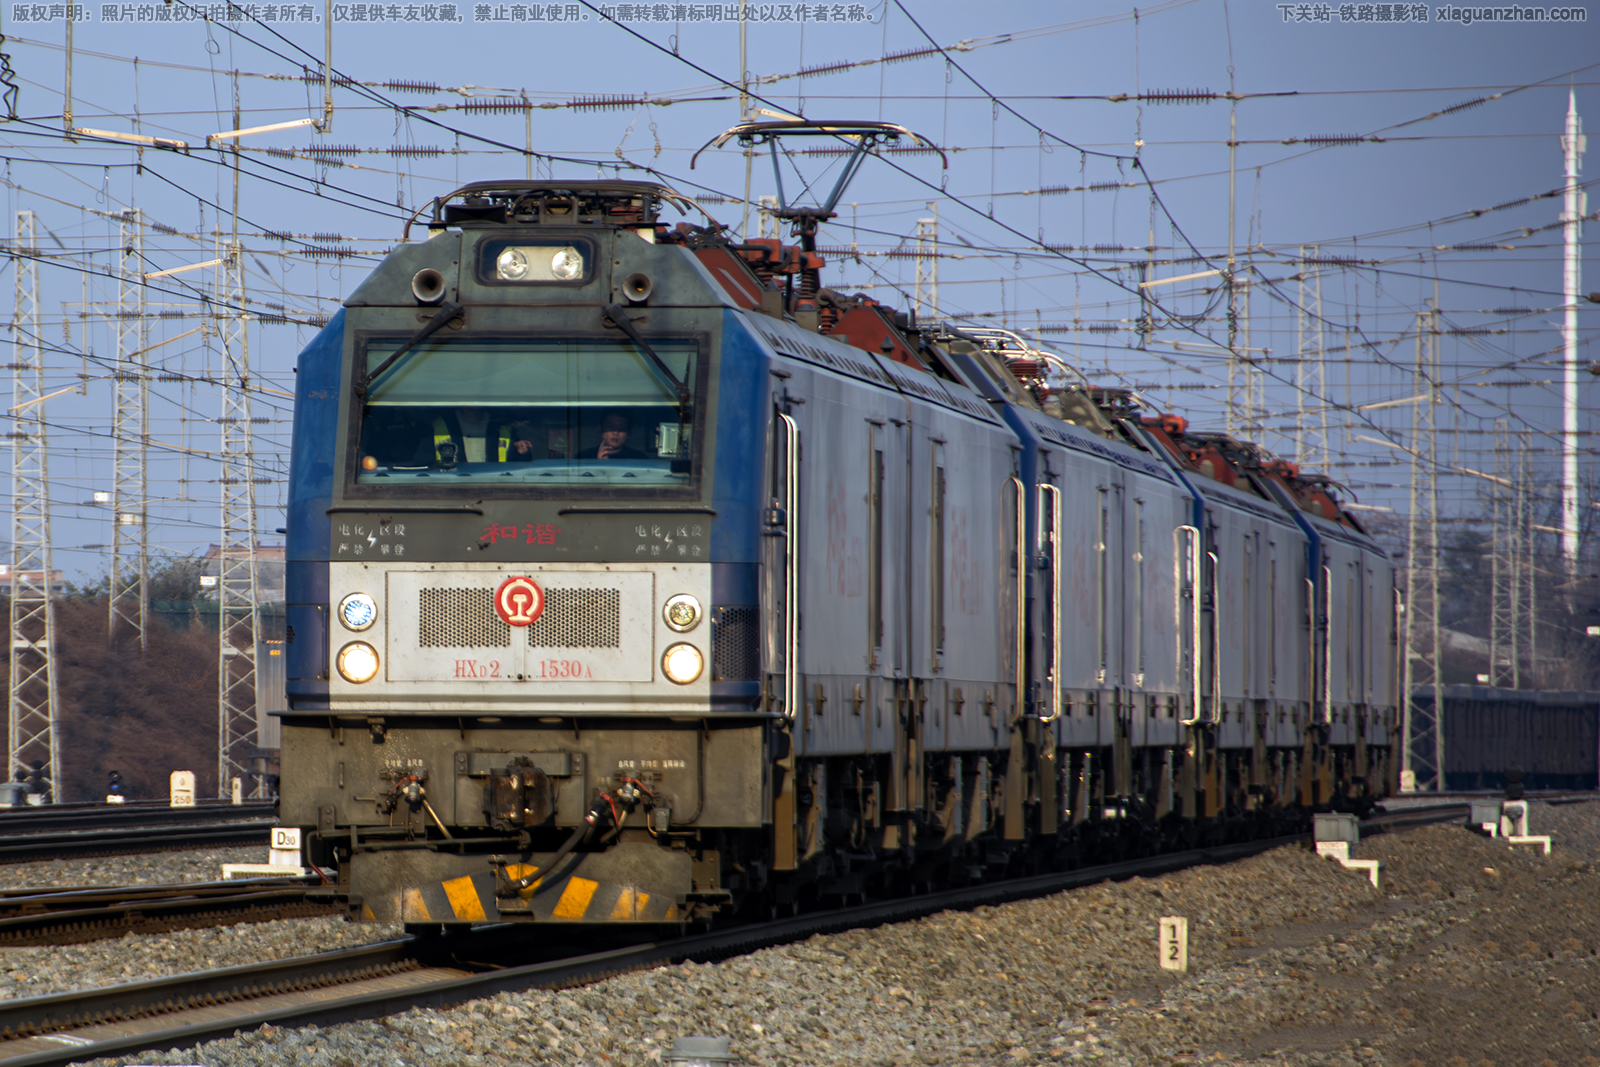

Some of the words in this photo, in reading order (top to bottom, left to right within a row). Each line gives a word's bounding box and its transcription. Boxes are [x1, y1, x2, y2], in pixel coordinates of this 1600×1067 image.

[480, 522, 561, 544] 和谐
[277, 831, 296, 845] D30
[1169, 924, 1176, 939] 1
[1169, 945, 1179, 960] 2
